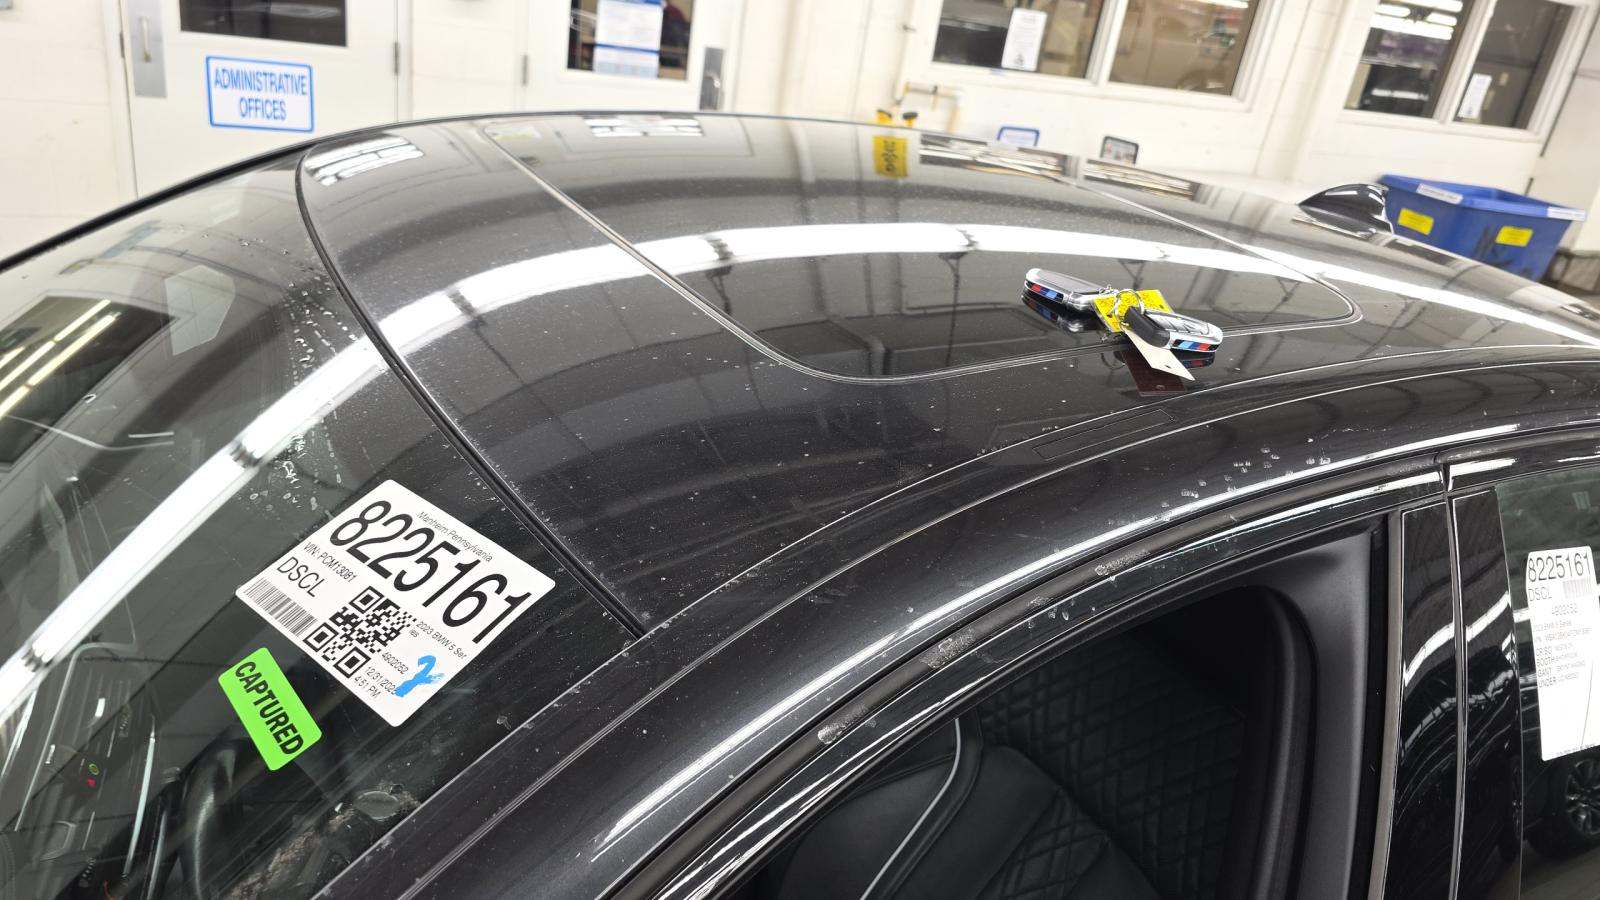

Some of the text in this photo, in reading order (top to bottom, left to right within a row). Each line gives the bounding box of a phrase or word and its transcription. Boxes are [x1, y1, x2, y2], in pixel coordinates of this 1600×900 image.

[214, 67, 307, 96] ADMINISTRATIVE
[239, 96, 288, 121] OFFICES
[416, 511, 493, 562] Manheim Pennsylvania
[276, 556, 325, 598] DSCL
[329, 500, 532, 644] 8225161
[1527, 551, 1591, 583] 8225161
[1527, 586, 1553, 602] DSCL
[415, 621, 434, 637] 2023
[431, 631, 451, 648] BMW
[354, 675, 382, 699] 4:51 PM
[235, 661, 305, 755] CAPTURED
